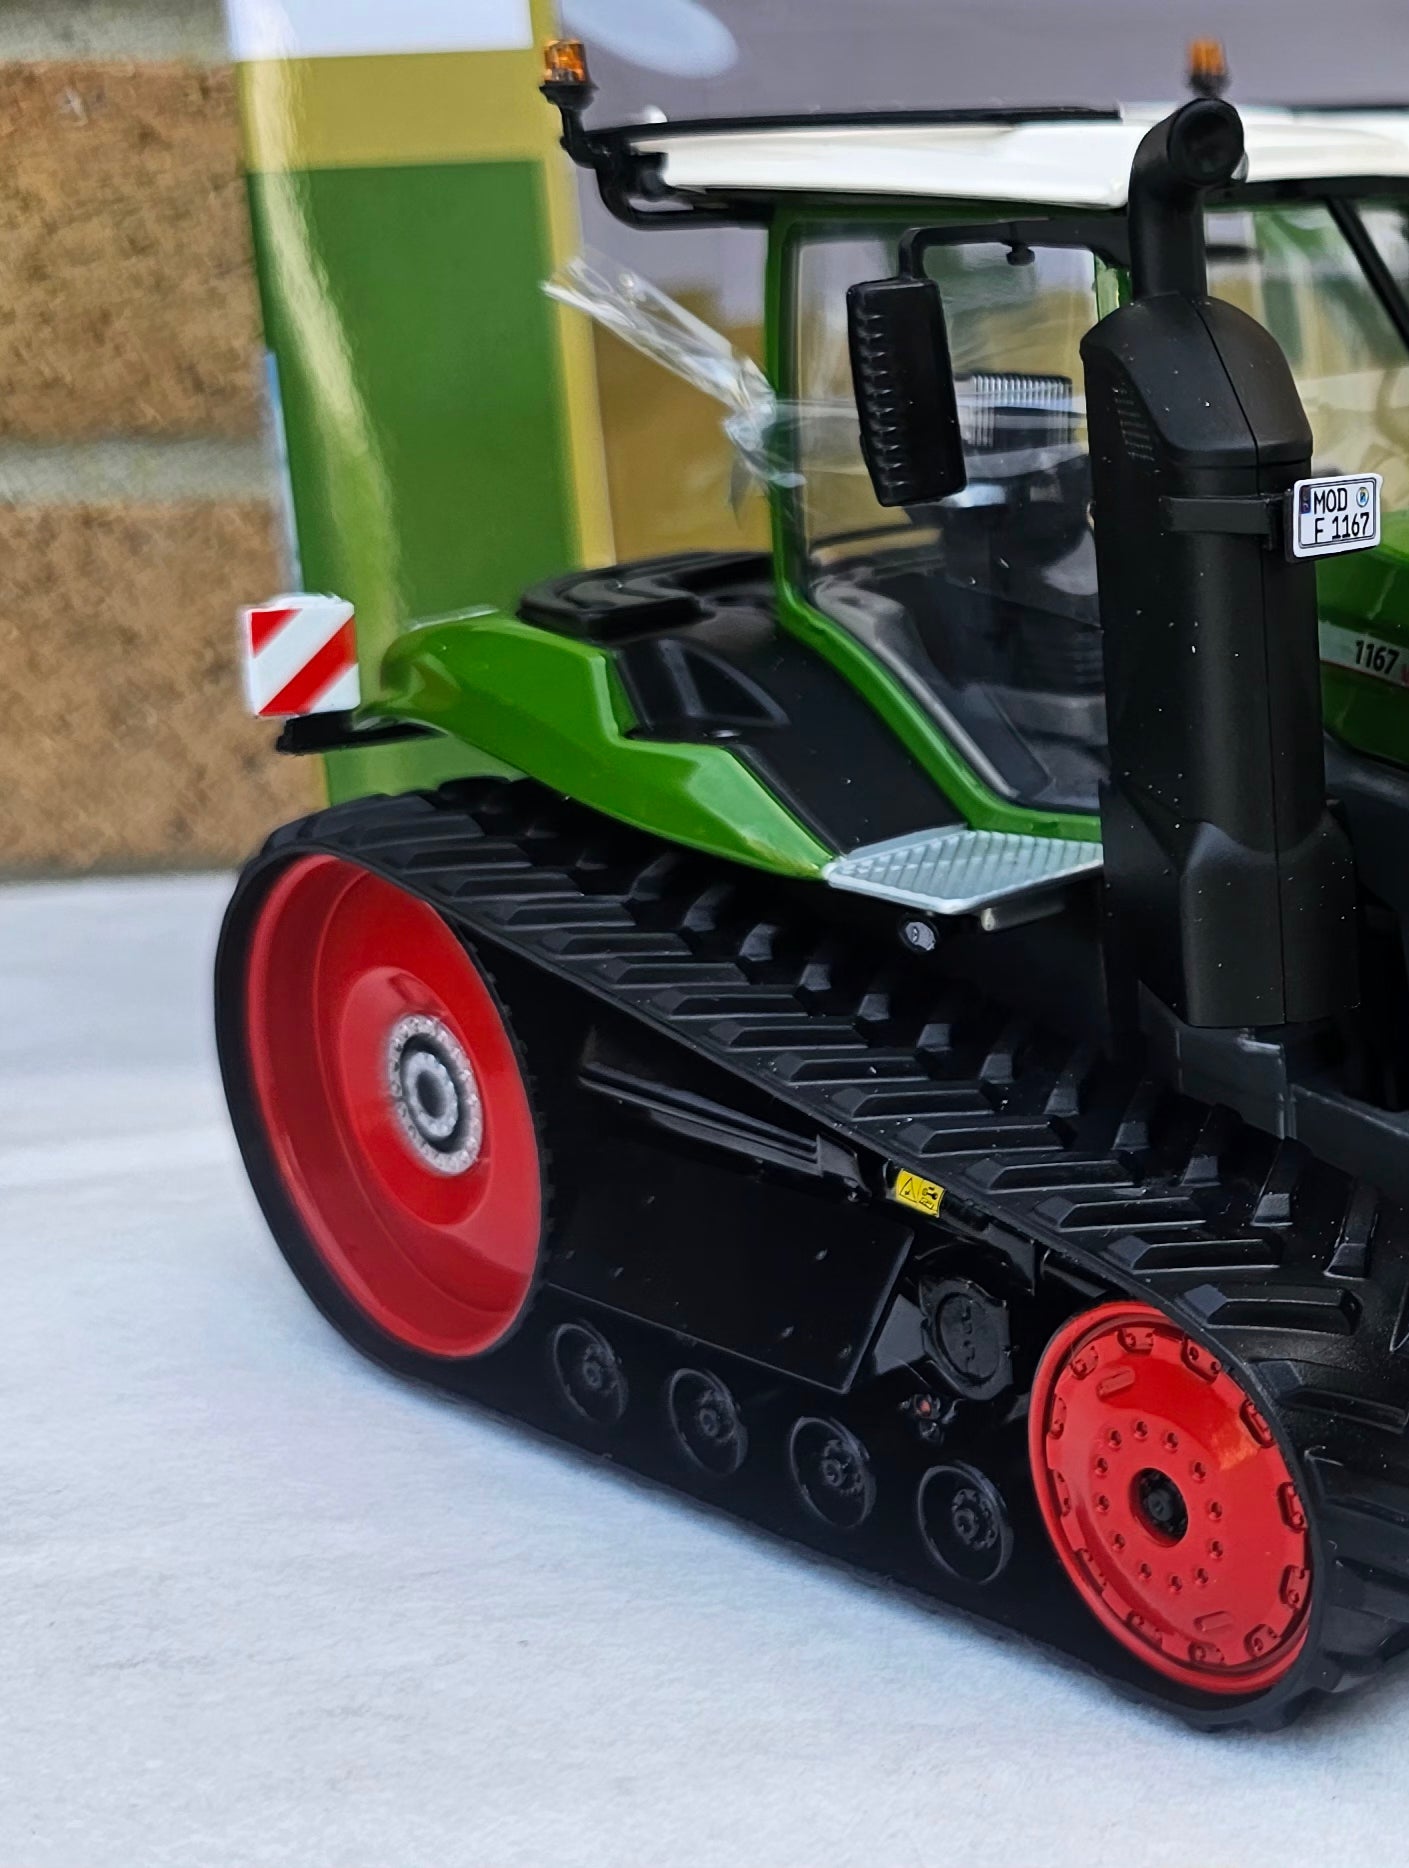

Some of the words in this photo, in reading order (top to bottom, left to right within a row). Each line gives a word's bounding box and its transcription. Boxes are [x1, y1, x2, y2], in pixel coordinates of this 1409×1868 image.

[1314, 487, 1347, 514] MOD
[1314, 517, 1325, 543] F
[1331, 511, 1370, 540] 1167
[1355, 640, 1400, 675] 1167
